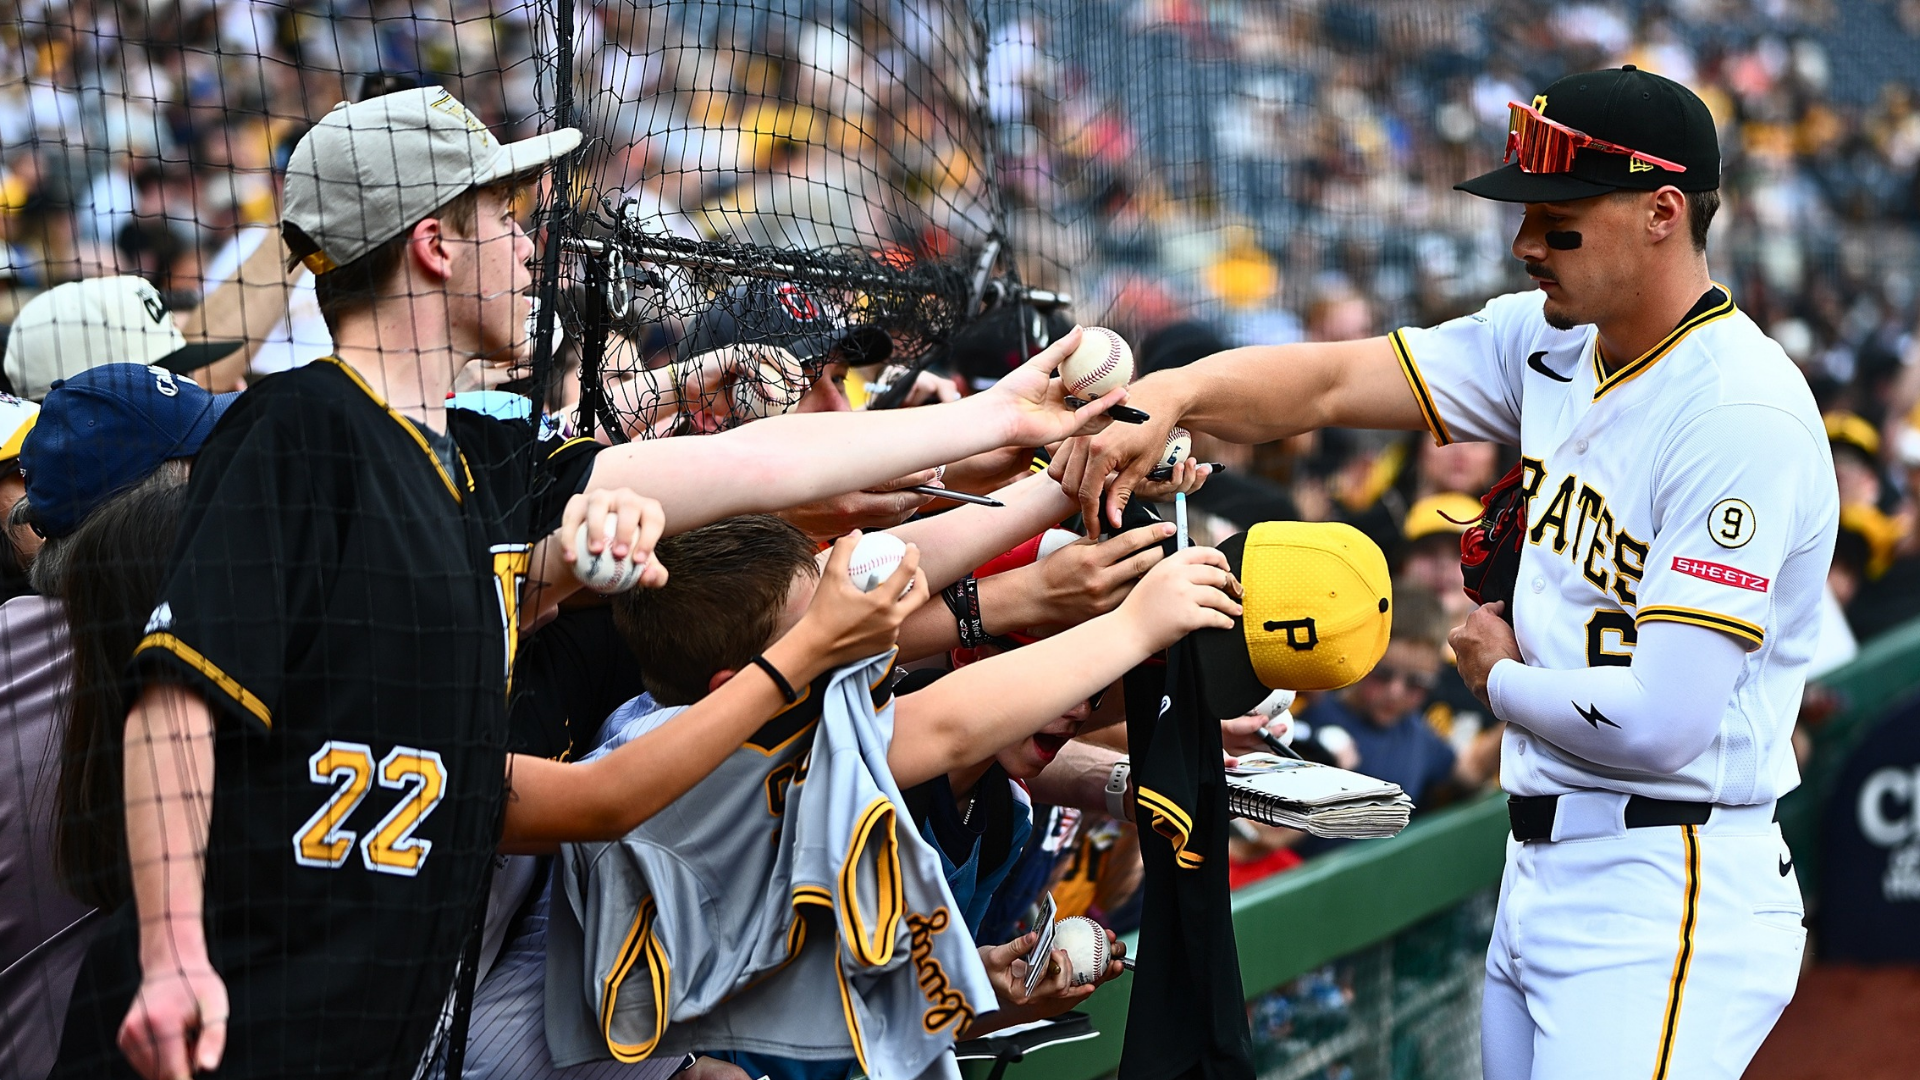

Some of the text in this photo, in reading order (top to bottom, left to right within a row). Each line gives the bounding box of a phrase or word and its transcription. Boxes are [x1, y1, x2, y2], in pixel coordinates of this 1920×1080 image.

[1720, 506, 1744, 541] 9
[1676, 558, 1766, 591] SHEETZ
[1262, 616, 1320, 652] P
[292, 739, 448, 877] 22
